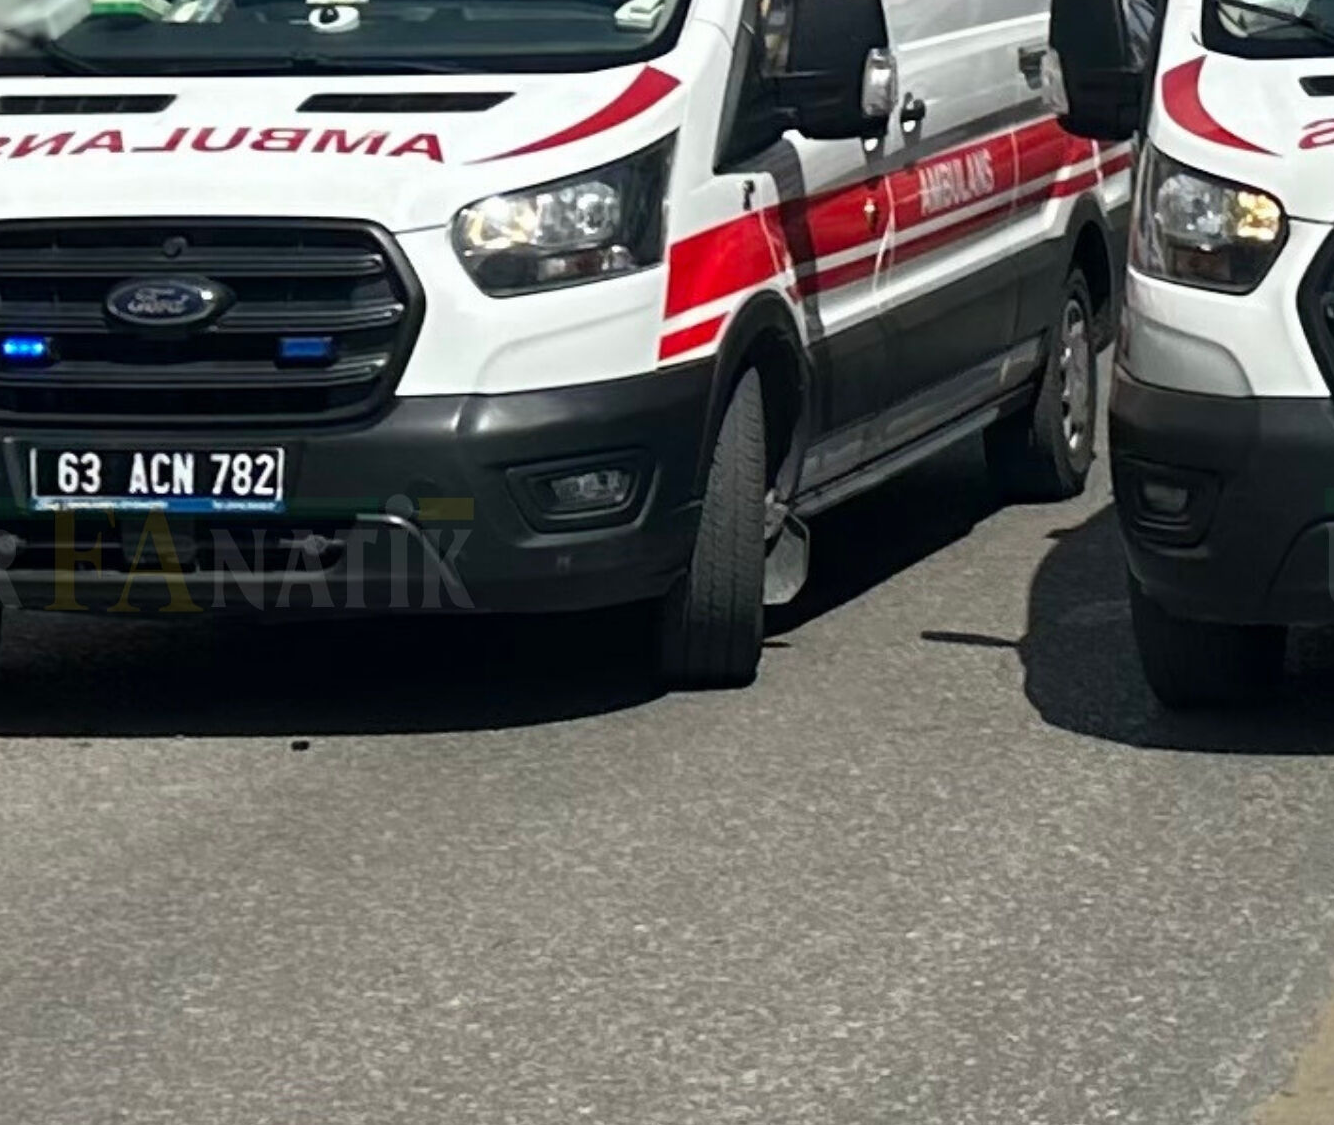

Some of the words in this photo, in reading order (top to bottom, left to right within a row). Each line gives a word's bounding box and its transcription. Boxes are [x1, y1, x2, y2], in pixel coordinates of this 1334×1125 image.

[57, 452, 102, 494] 63
[128, 452, 195, 495] ACN
[209, 452, 276, 495] 782
